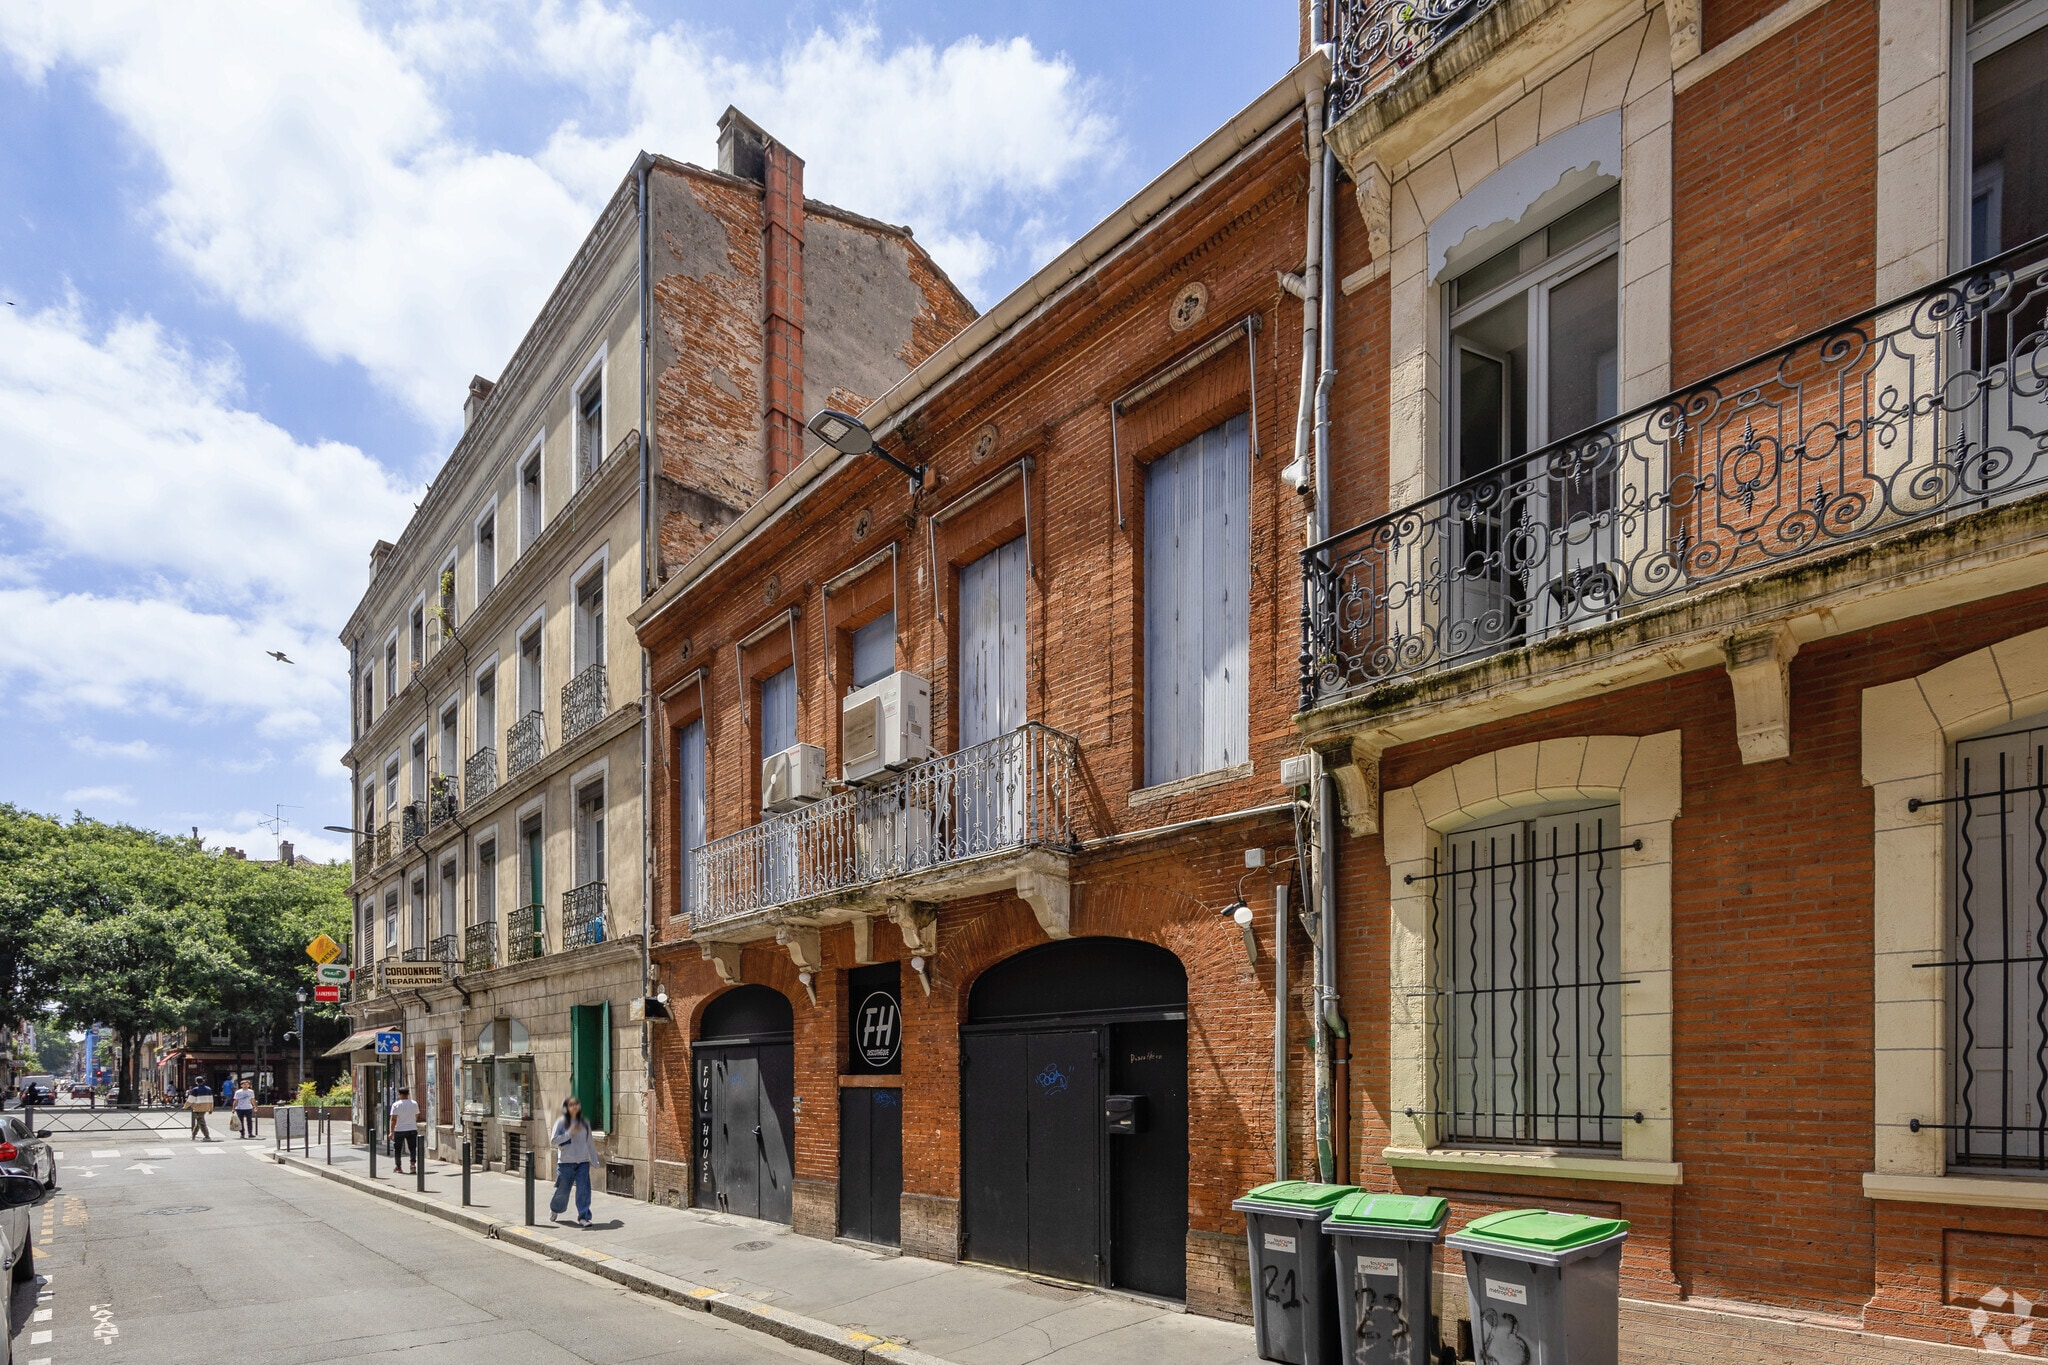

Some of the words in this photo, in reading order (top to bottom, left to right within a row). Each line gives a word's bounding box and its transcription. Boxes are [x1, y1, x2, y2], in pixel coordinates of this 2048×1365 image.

[320, 947, 338, 964] PRESSE
[385, 967, 442, 976] CORDONNERIE
[863, 1005, 894, 1047] FH
[1498, 1285, 1523, 1295] toulouse
